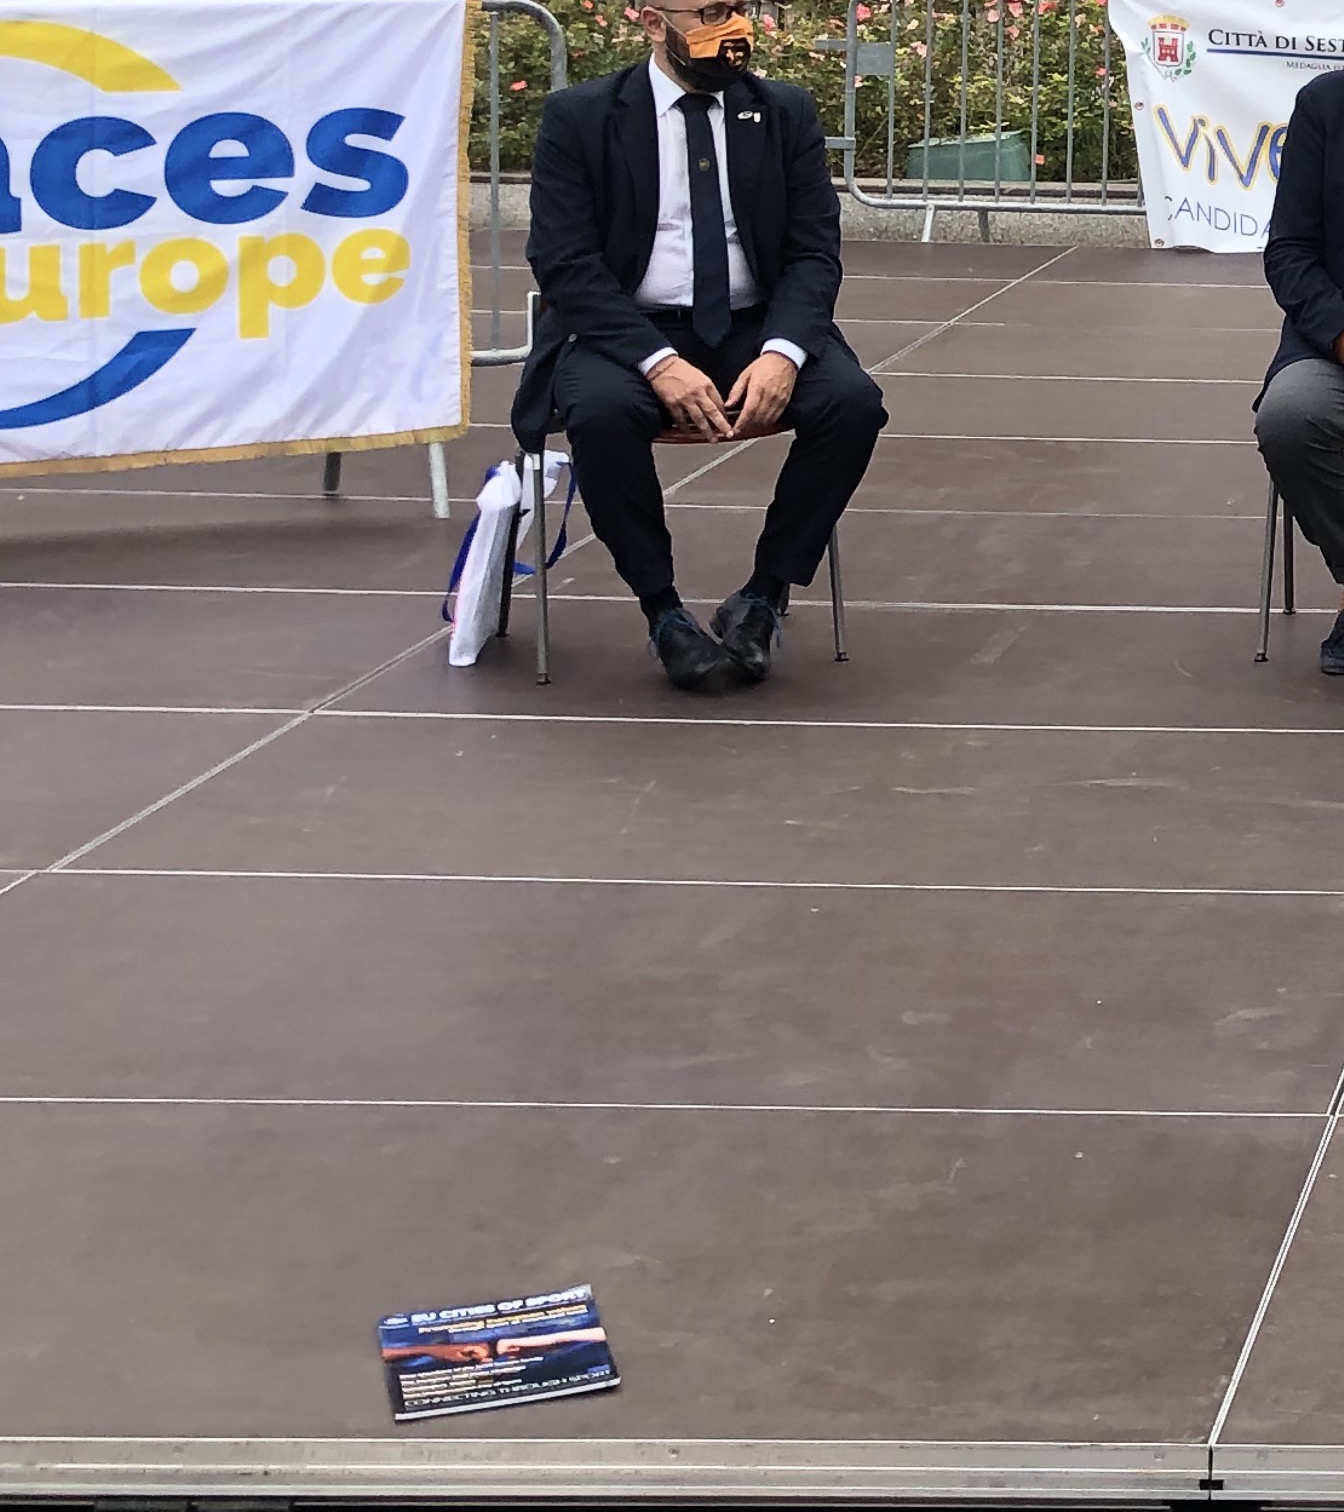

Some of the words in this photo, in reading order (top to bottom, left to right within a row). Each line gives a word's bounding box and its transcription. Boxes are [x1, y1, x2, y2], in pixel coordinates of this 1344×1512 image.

[1208, 29, 1267, 48] CITTÀ
[1276, 38, 1297, 51] DI
[0, 107, 409, 234] ces
[1154, 105, 1287, 190] Vive
[0, 228, 411, 340] urope
